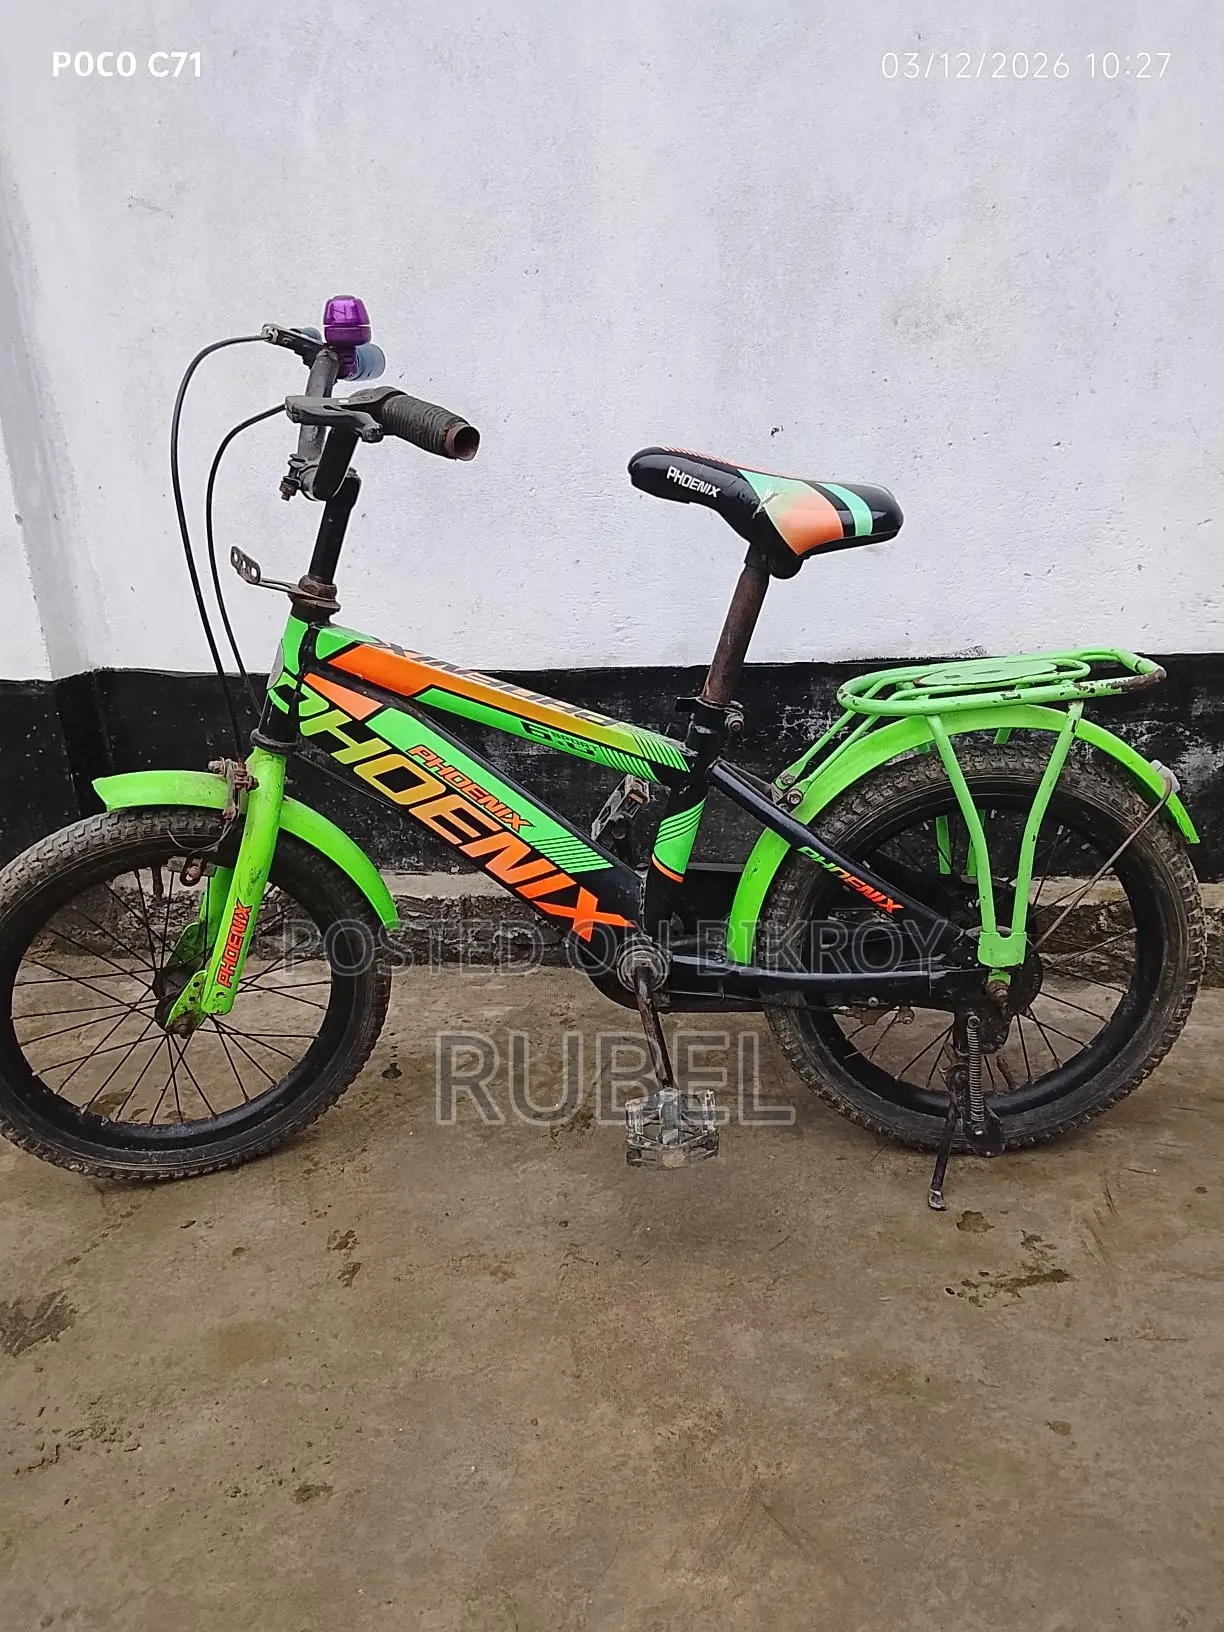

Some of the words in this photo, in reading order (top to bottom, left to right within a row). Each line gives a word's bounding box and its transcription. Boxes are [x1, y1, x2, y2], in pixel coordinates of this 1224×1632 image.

[666, 465, 722, 499] PHOENIX
[407, 744, 537, 832] PHOENIX
[796, 846, 905, 914] PHOENIX
[216, 899, 253, 988] PHOENIX
